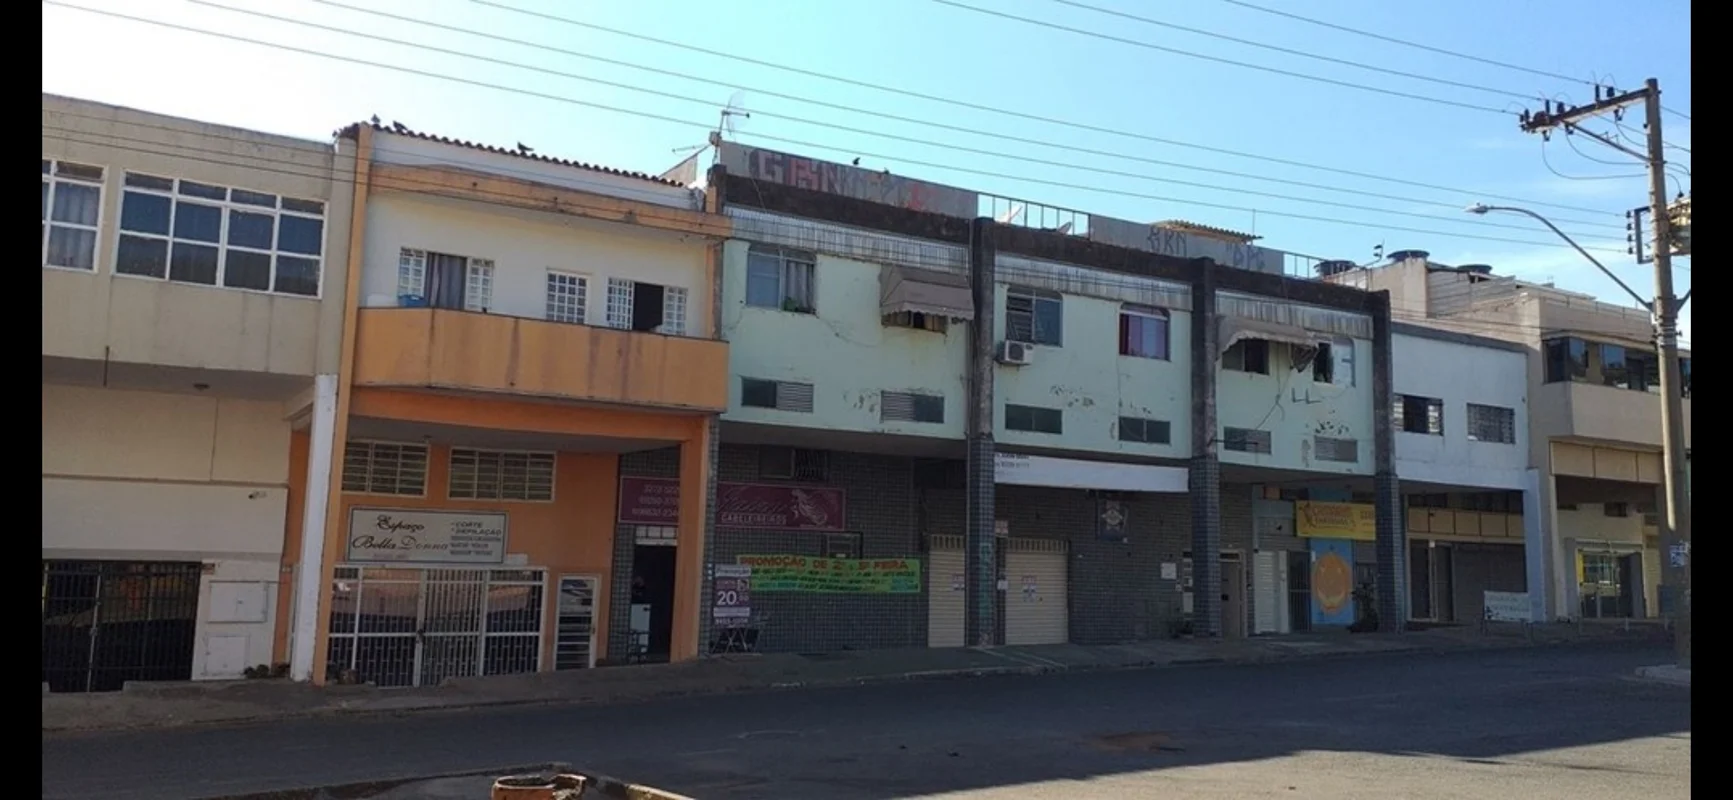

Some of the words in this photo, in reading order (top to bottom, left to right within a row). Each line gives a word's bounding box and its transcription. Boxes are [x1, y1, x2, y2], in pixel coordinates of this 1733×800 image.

[377, 514, 425, 533] Espaço
[455, 521, 484, 529] CORTE
[352, 535, 396, 550] Bella
[400, 535, 449, 550] Donna
[739, 555, 807, 569] PROMOÇÃO
[812, 559, 828, 569] DE
